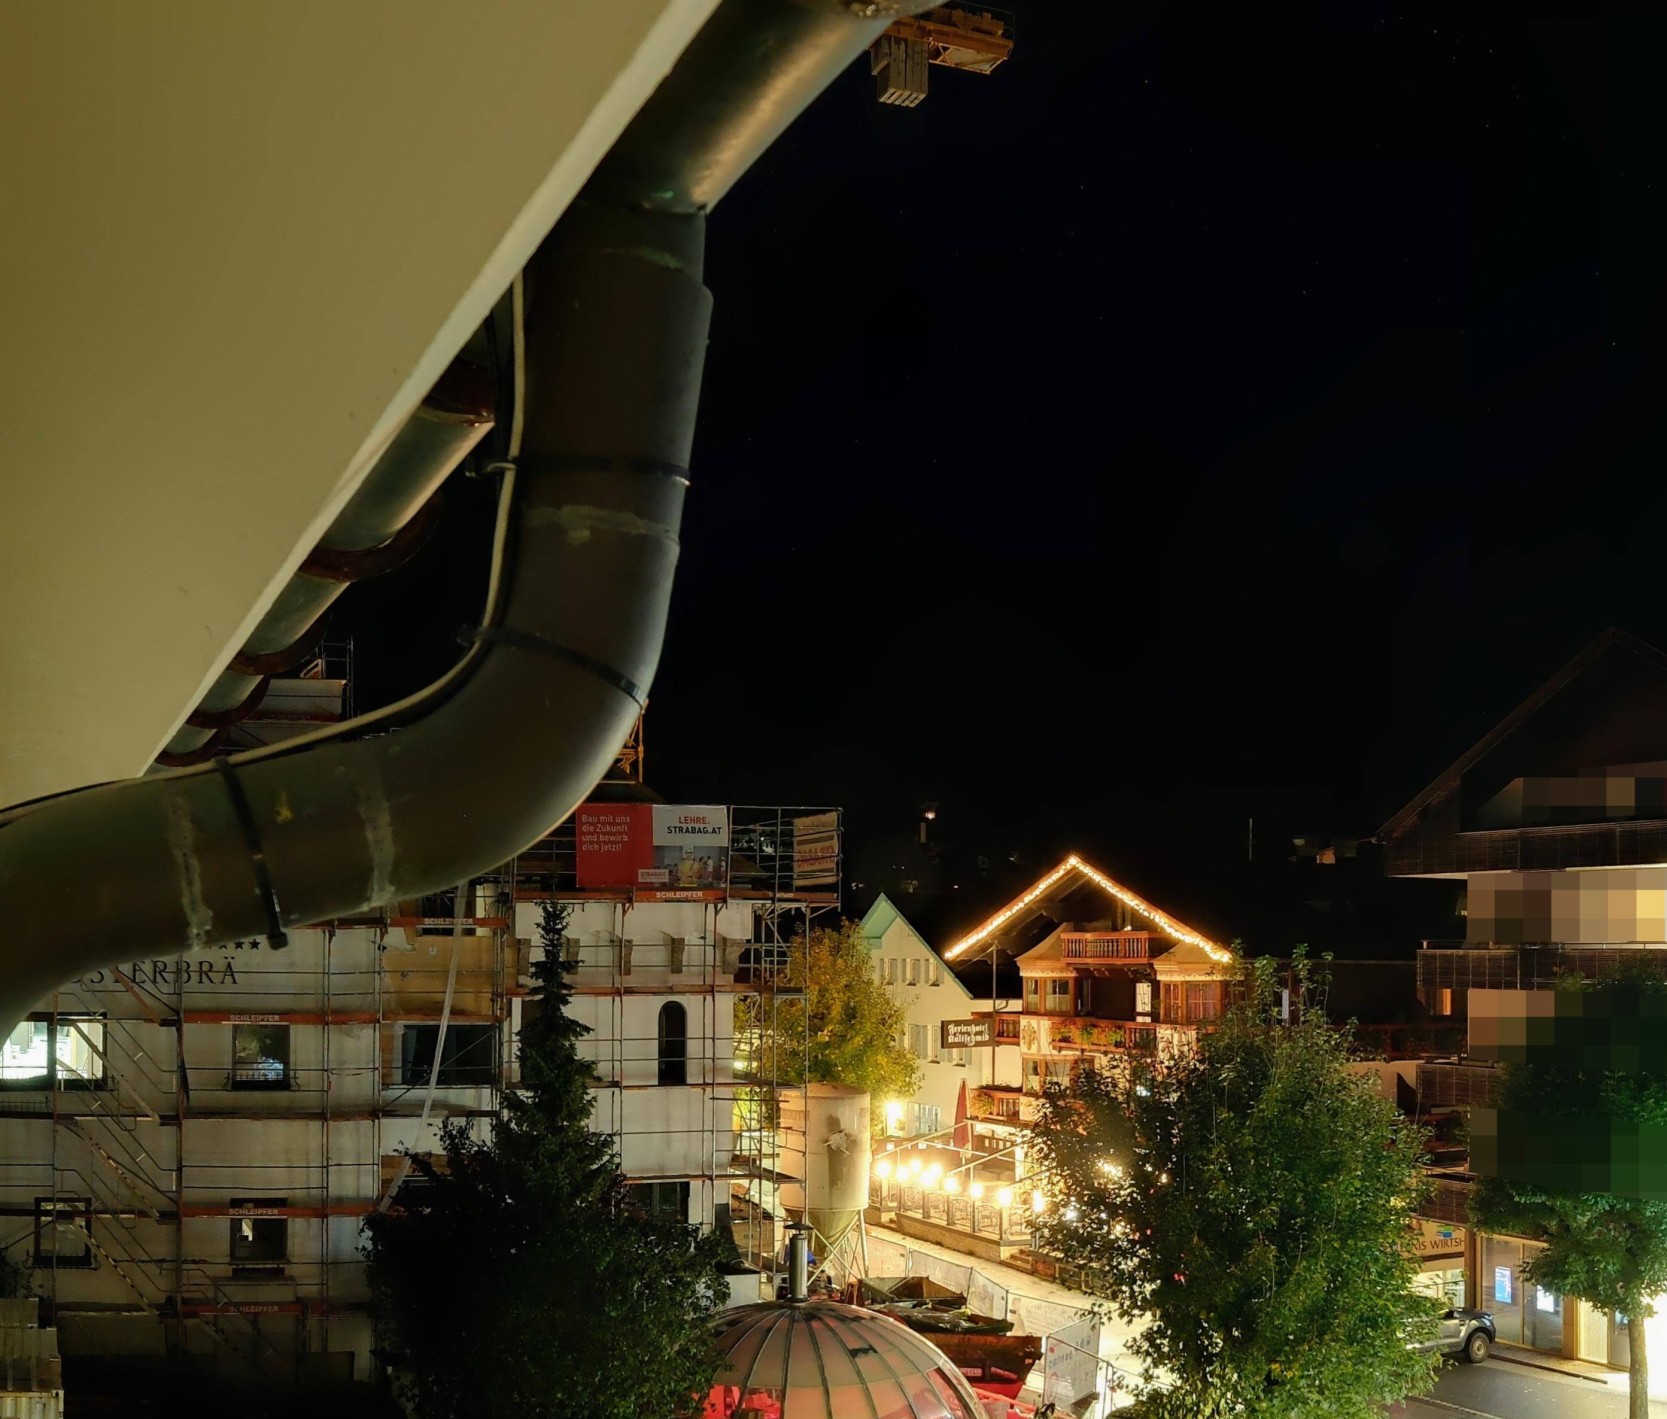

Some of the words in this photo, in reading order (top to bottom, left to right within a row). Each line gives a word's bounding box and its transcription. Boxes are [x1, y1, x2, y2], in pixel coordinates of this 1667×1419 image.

[582, 815, 597, 823] Bau
[599, 815, 613, 823] mit
[678, 816, 710, 825] LEHRE.
[582, 824, 594, 832] die
[596, 824, 628, 832] Zukunft
[667, 826, 722, 835] STRABAG.AT
[582, 843, 598, 851] dich
[600, 843, 622, 852] jetzt!
